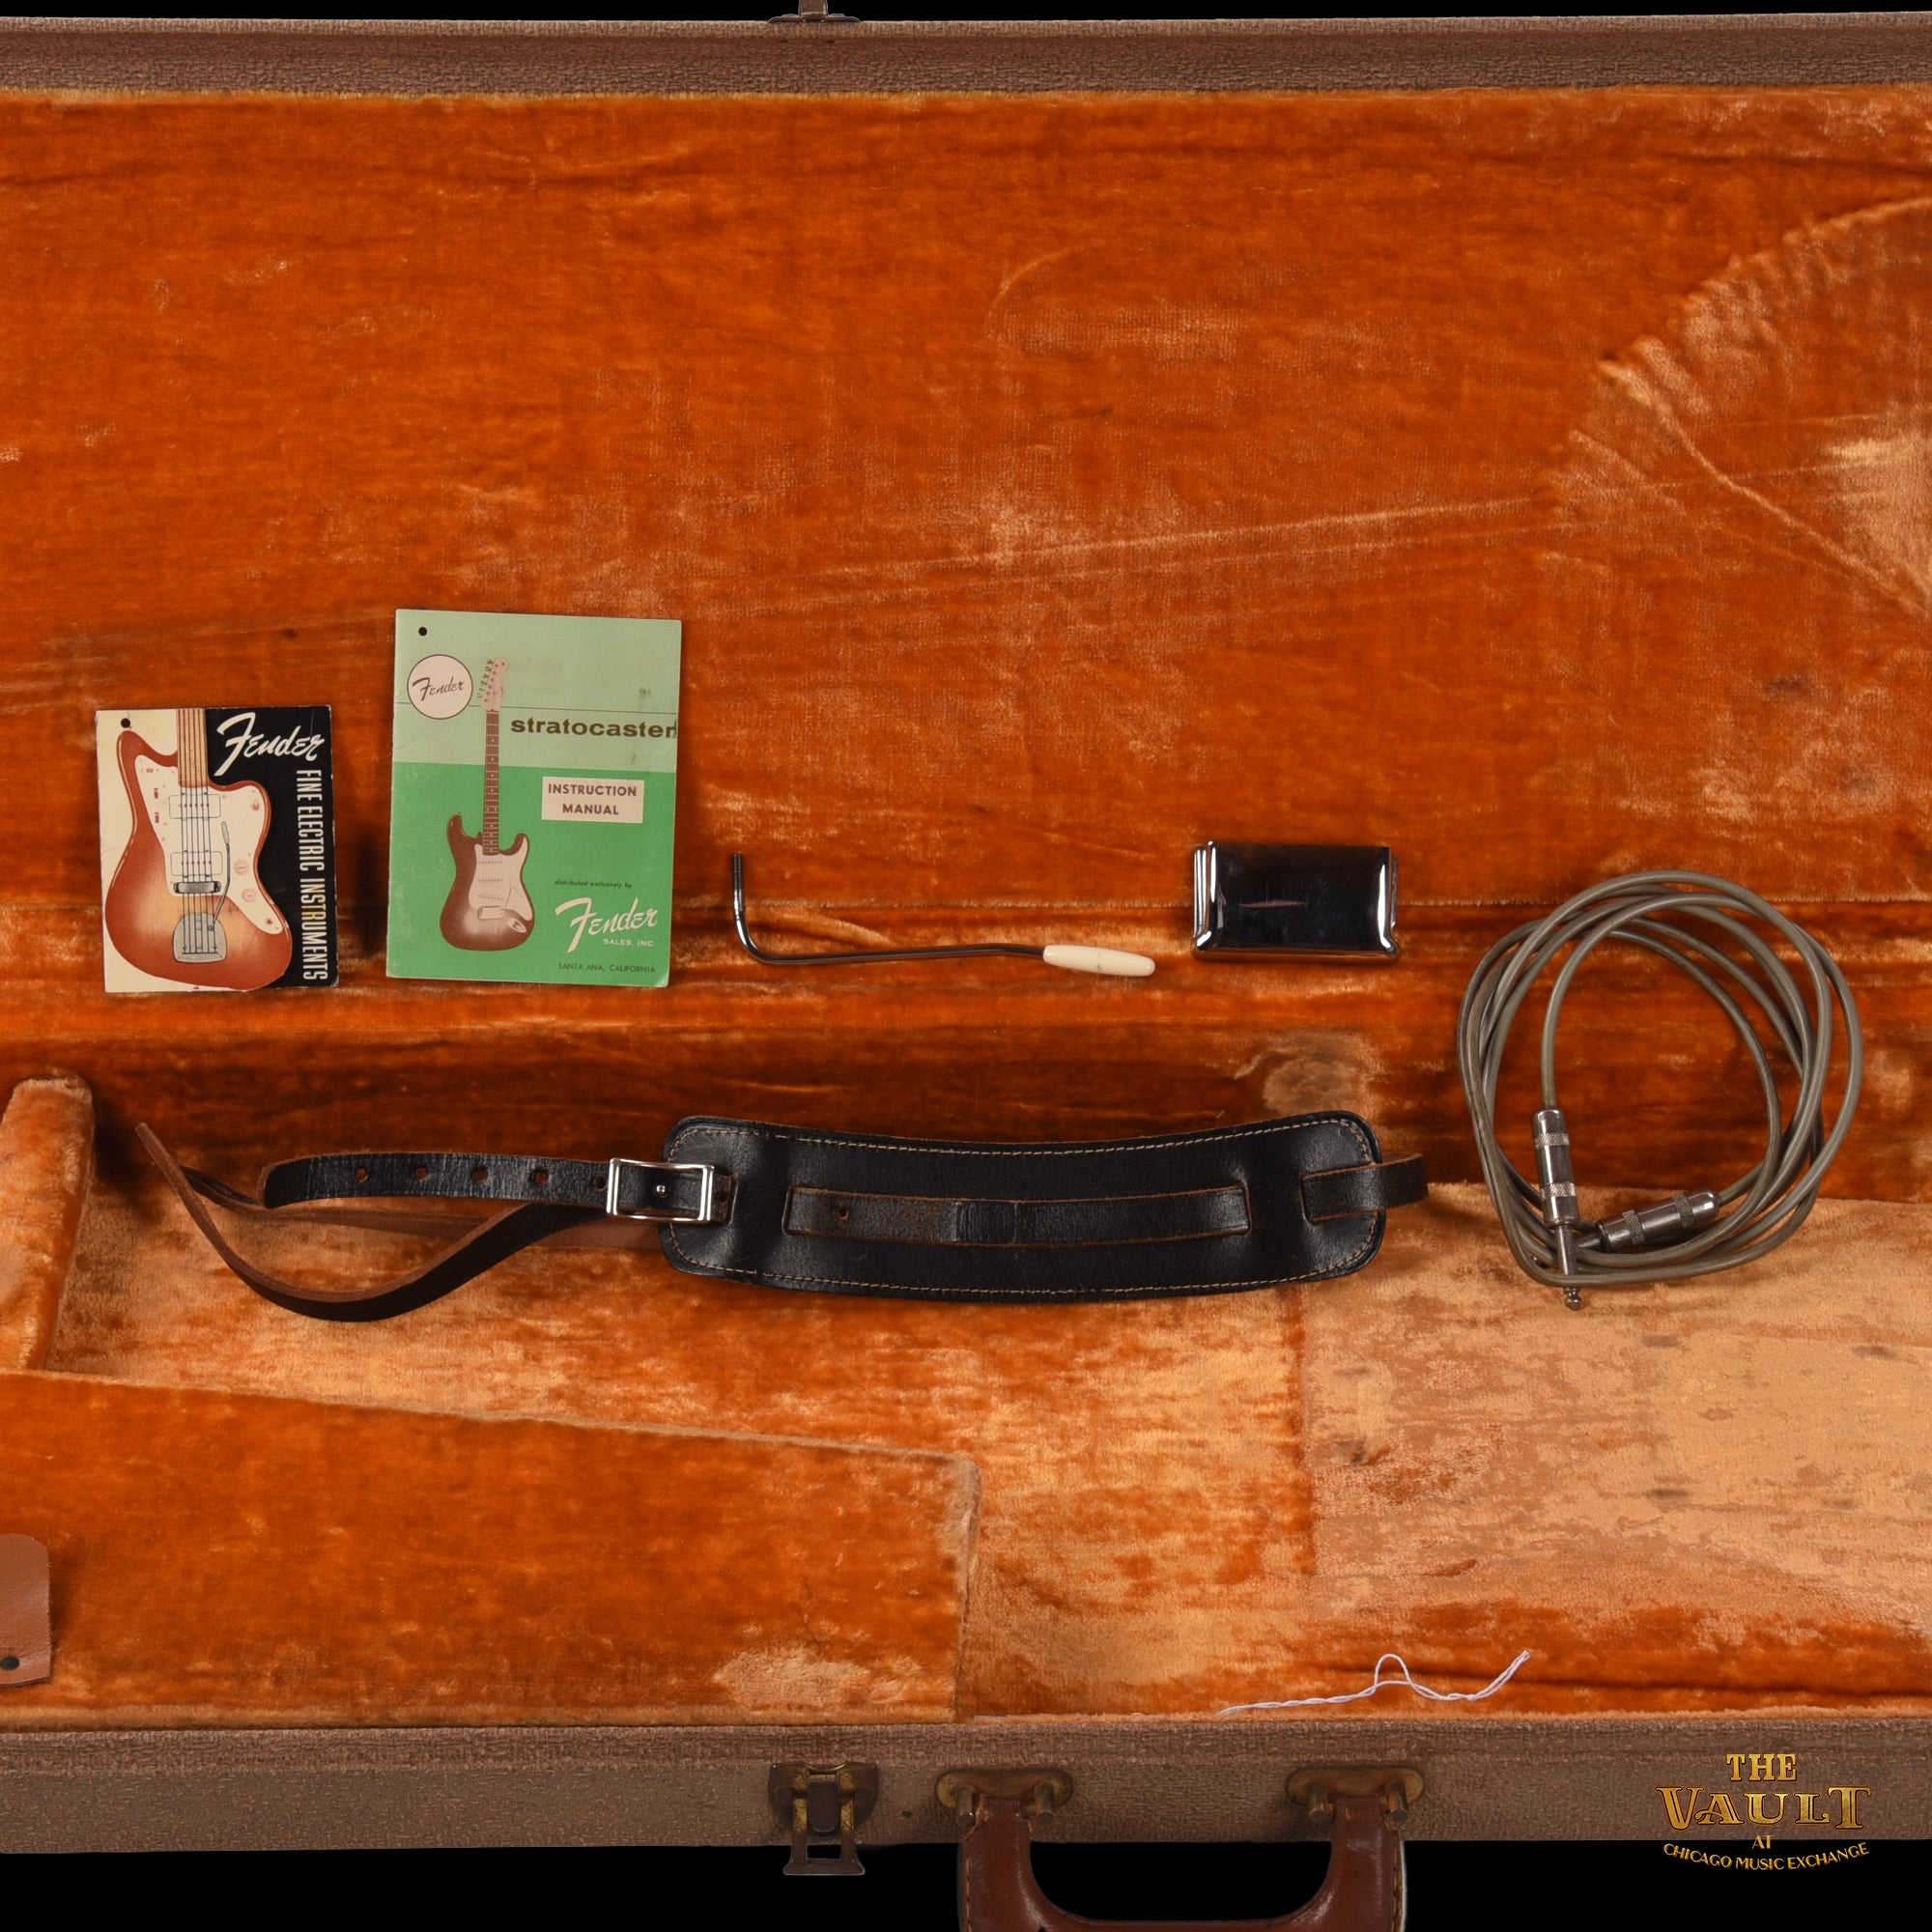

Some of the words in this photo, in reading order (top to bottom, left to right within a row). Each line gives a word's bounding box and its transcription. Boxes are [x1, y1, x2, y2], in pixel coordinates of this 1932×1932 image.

[412, 676, 464, 701] Fender
[510, 718, 677, 739] stratocaster
[214, 712, 326, 777] Fender
[296, 769, 323, 801] FINE
[548, 783, 638, 796] INSTRUCTION
[562, 804, 619, 814] MANUAL
[297, 807, 326, 872] ELECTRIC
[299, 877, 328, 980] INSTRUMENTS
[554, 897, 659, 953] Fender
[609, 964, 656, 973] CALIFORNIA
